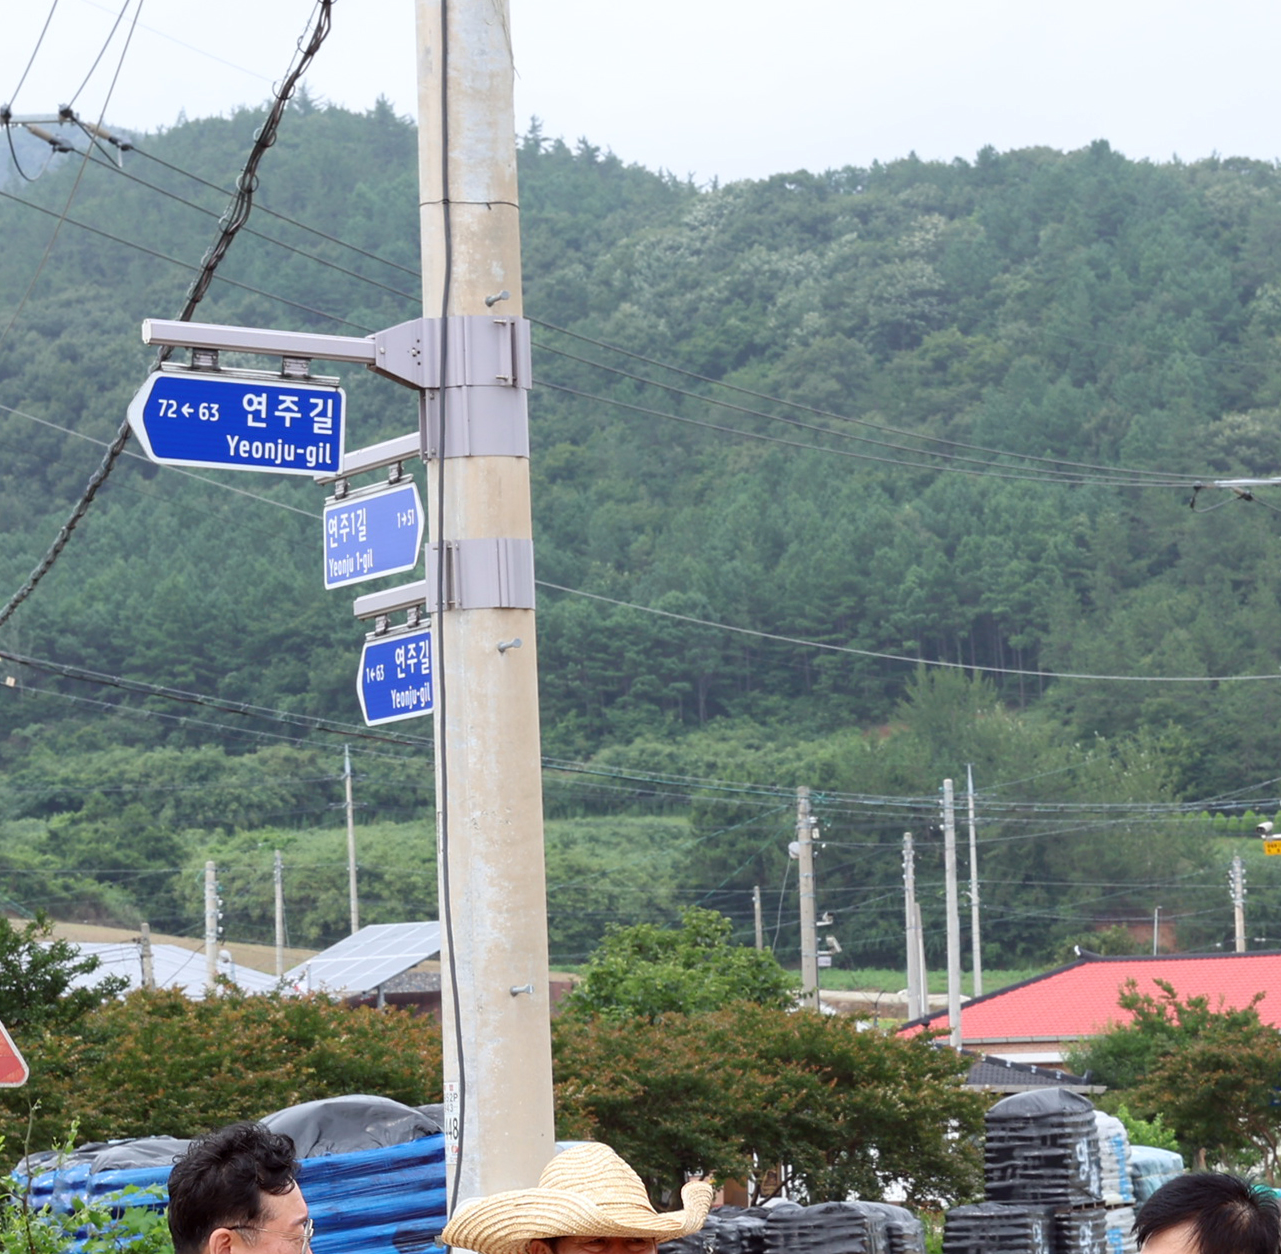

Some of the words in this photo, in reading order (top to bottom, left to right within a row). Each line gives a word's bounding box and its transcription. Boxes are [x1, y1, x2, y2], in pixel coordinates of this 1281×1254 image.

[158, 399, 178, 418] 72
[198, 402, 220, 422] 63
[242, 392, 333, 435] 연주길
[226, 434, 333, 467] Yeonju-gil
[328, 507, 367, 548] 연주1길
[328, 554, 354, 578] Yeonju
[355, 548, 373, 573] 1-gil
[395, 639, 430, 679] 연주길
[390, 682, 431, 710] Yeonju-gil
